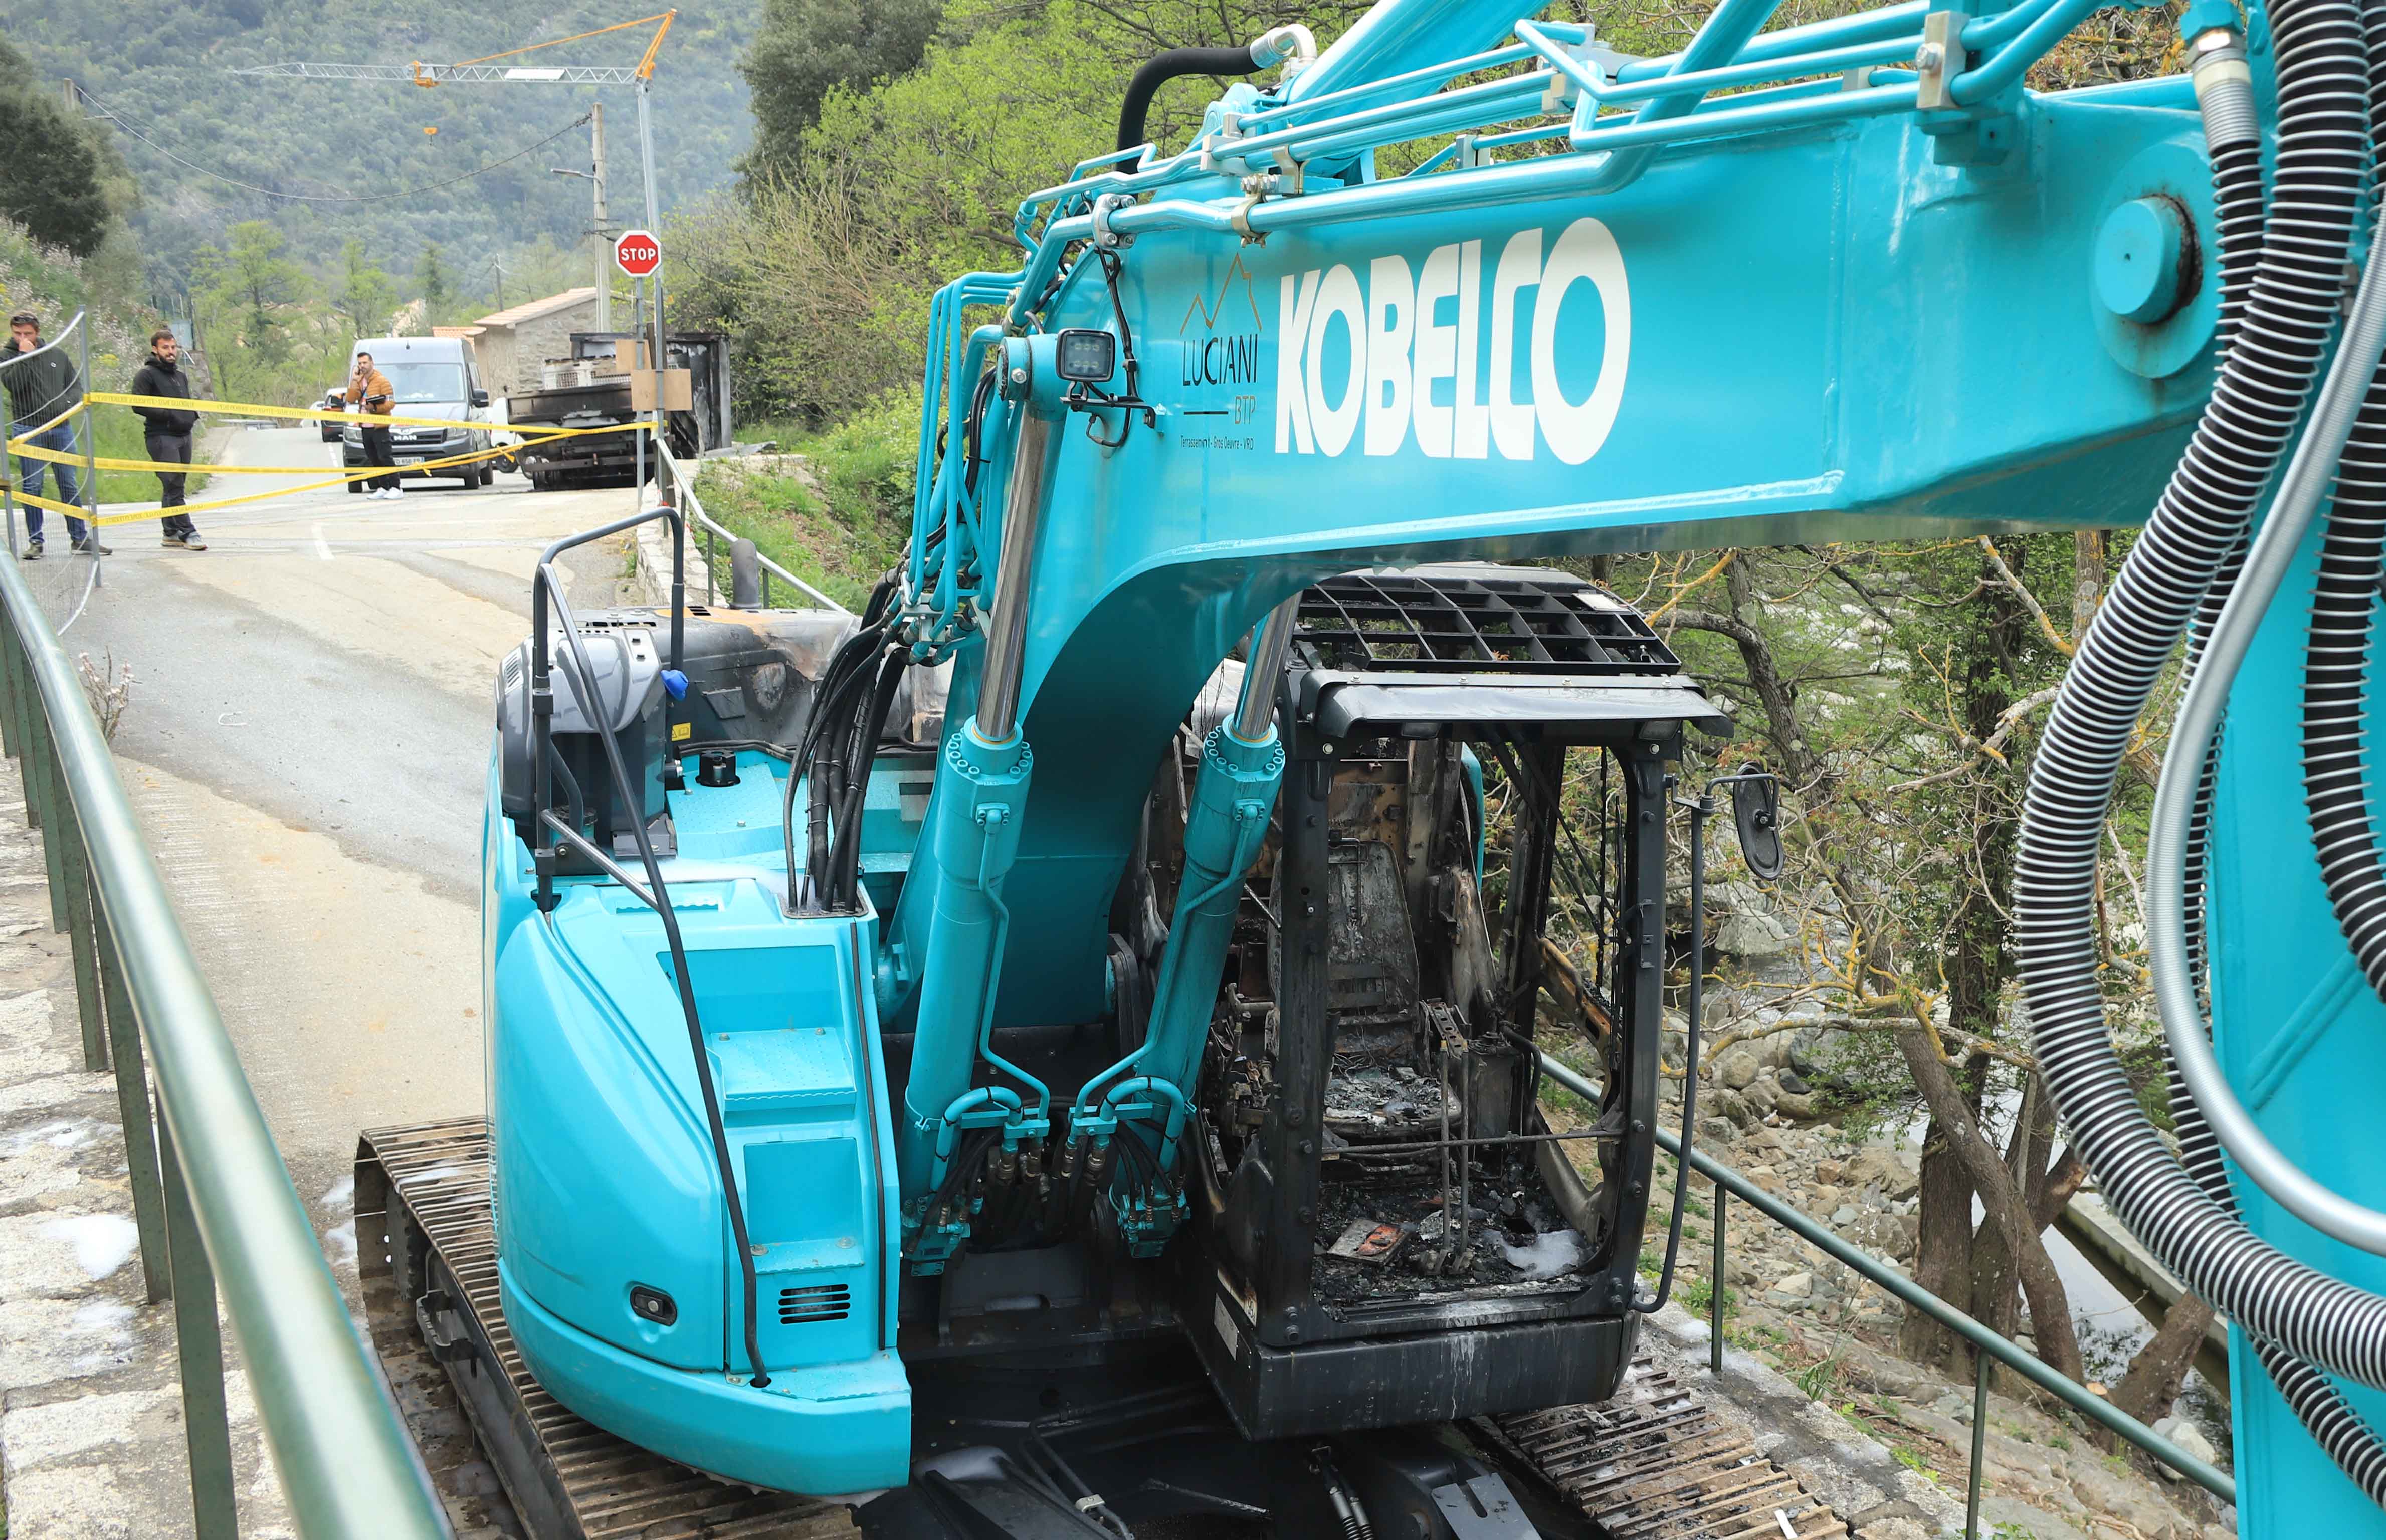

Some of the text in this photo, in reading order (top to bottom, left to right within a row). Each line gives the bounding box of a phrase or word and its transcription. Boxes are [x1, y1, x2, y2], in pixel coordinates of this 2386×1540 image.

[621, 248, 656, 261] STOP
[1274, 216, 1631, 465] KOBELCO
[1183, 334, 1258, 386] LUCIANI
[1235, 395, 1256, 424] BTP
[1214, 436, 1223, 448] Gros
[1224, 436, 1240, 450] Oeuvre
[1244, 438, 1254, 450] VRD
